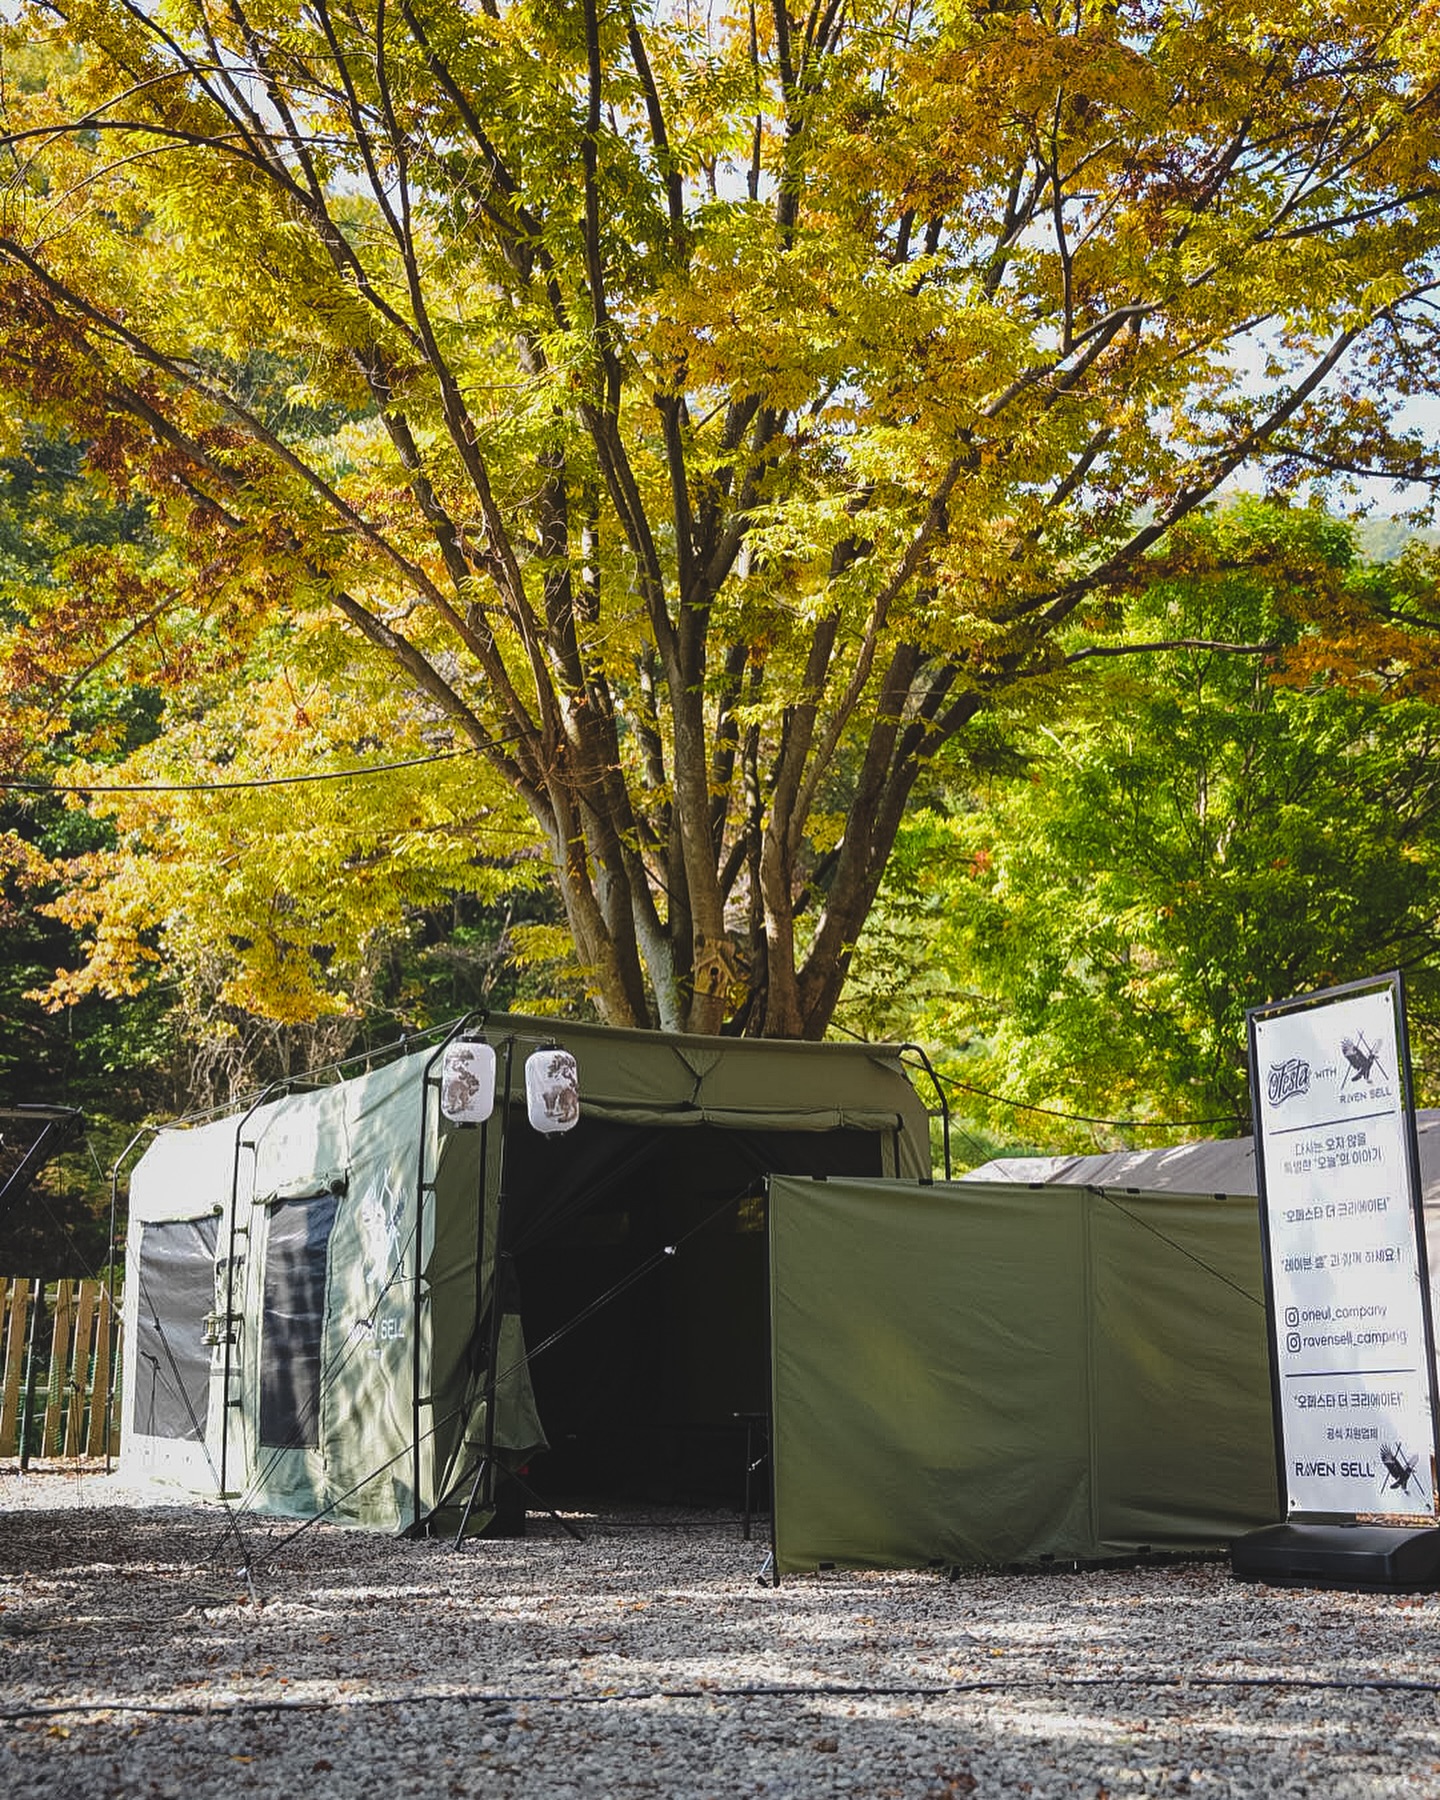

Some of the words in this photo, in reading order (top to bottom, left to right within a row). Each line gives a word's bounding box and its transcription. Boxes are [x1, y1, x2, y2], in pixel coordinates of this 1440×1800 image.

[1315, 1067, 1336, 1080] WITH
[1369, 1086, 1392, 1099] SELL
[1295, 1141, 1324, 1157] 다시는
[1325, 1136, 1345, 1151] 오지
[1352, 1146, 1382, 1164] 이야기
[1325, 1204, 1335, 1218] 더
[1302, 1305, 1388, 1321] oneul_company
[1303, 1330, 1408, 1347] ravensell_camping
[1338, 1393, 1348, 1407] 더
[1327, 1427, 1344, 1440] 공식
[1340, 1462, 1375, 1478] SELL
